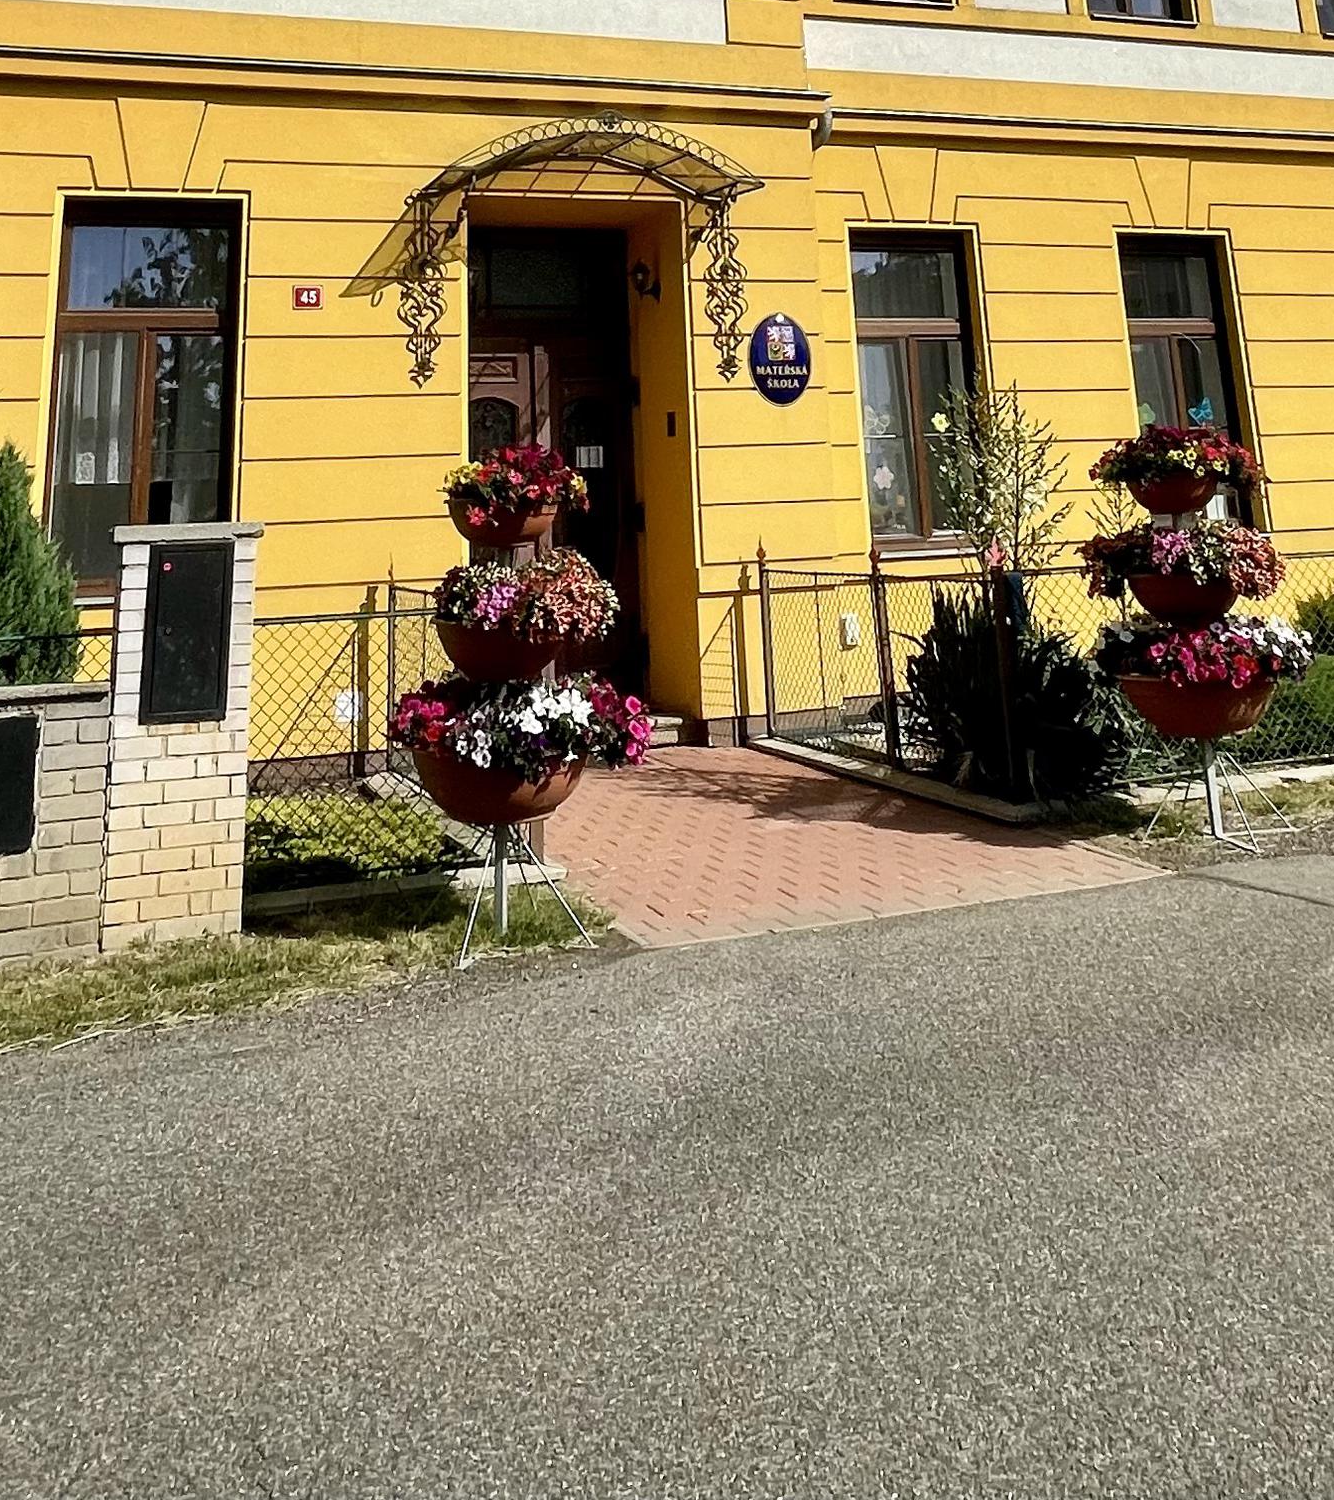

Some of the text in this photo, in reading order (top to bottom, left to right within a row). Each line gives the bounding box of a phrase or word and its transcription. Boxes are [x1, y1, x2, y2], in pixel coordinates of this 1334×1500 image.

[300, 290, 317, 304] 45
[756, 364, 808, 375] MATEŘSKÁ
[767, 377, 799, 388] ŠKOLA
